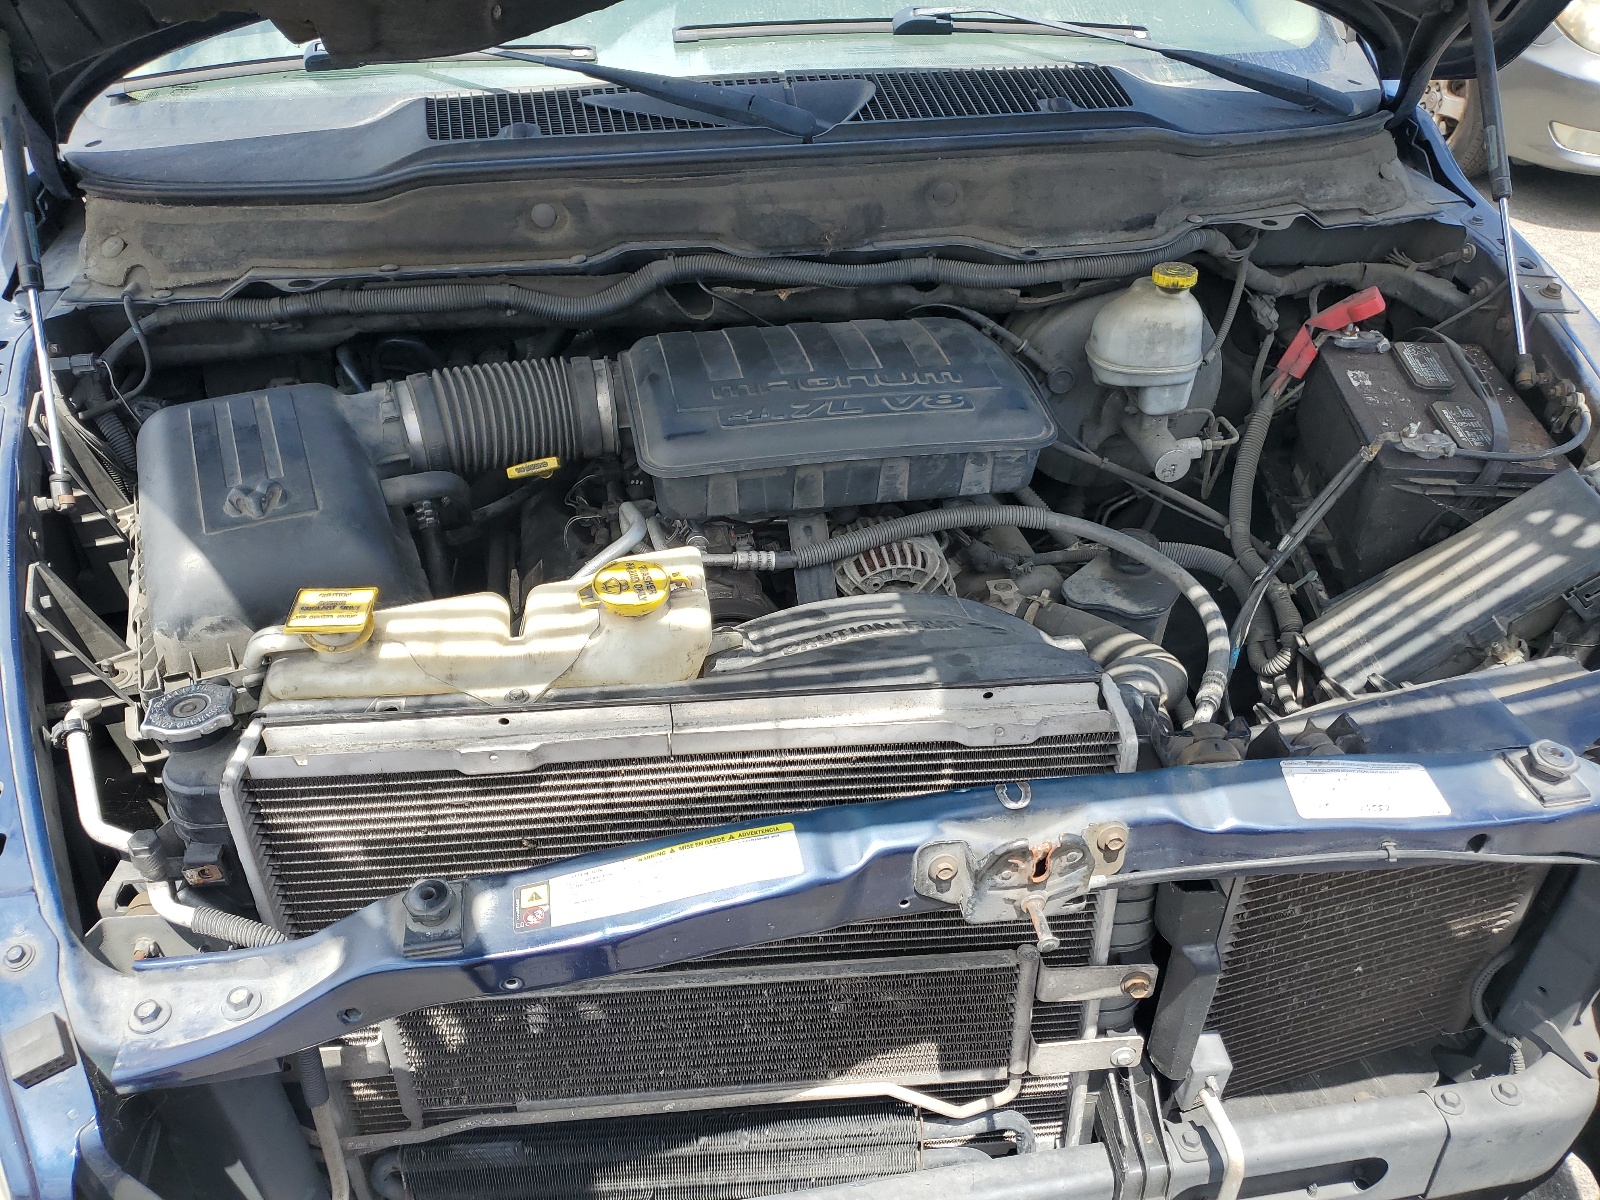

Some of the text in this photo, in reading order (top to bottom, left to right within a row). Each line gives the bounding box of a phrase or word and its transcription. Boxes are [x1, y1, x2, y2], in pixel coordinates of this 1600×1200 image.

[881, 394, 966, 412] V8
[637, 850, 667, 862] WARNING
[678, 843, 695, 852] MISE
[695, 841, 705, 849] EN
[704, 836, 726, 846] GARDE
[737, 826, 780, 839] ADVERTENCIA
